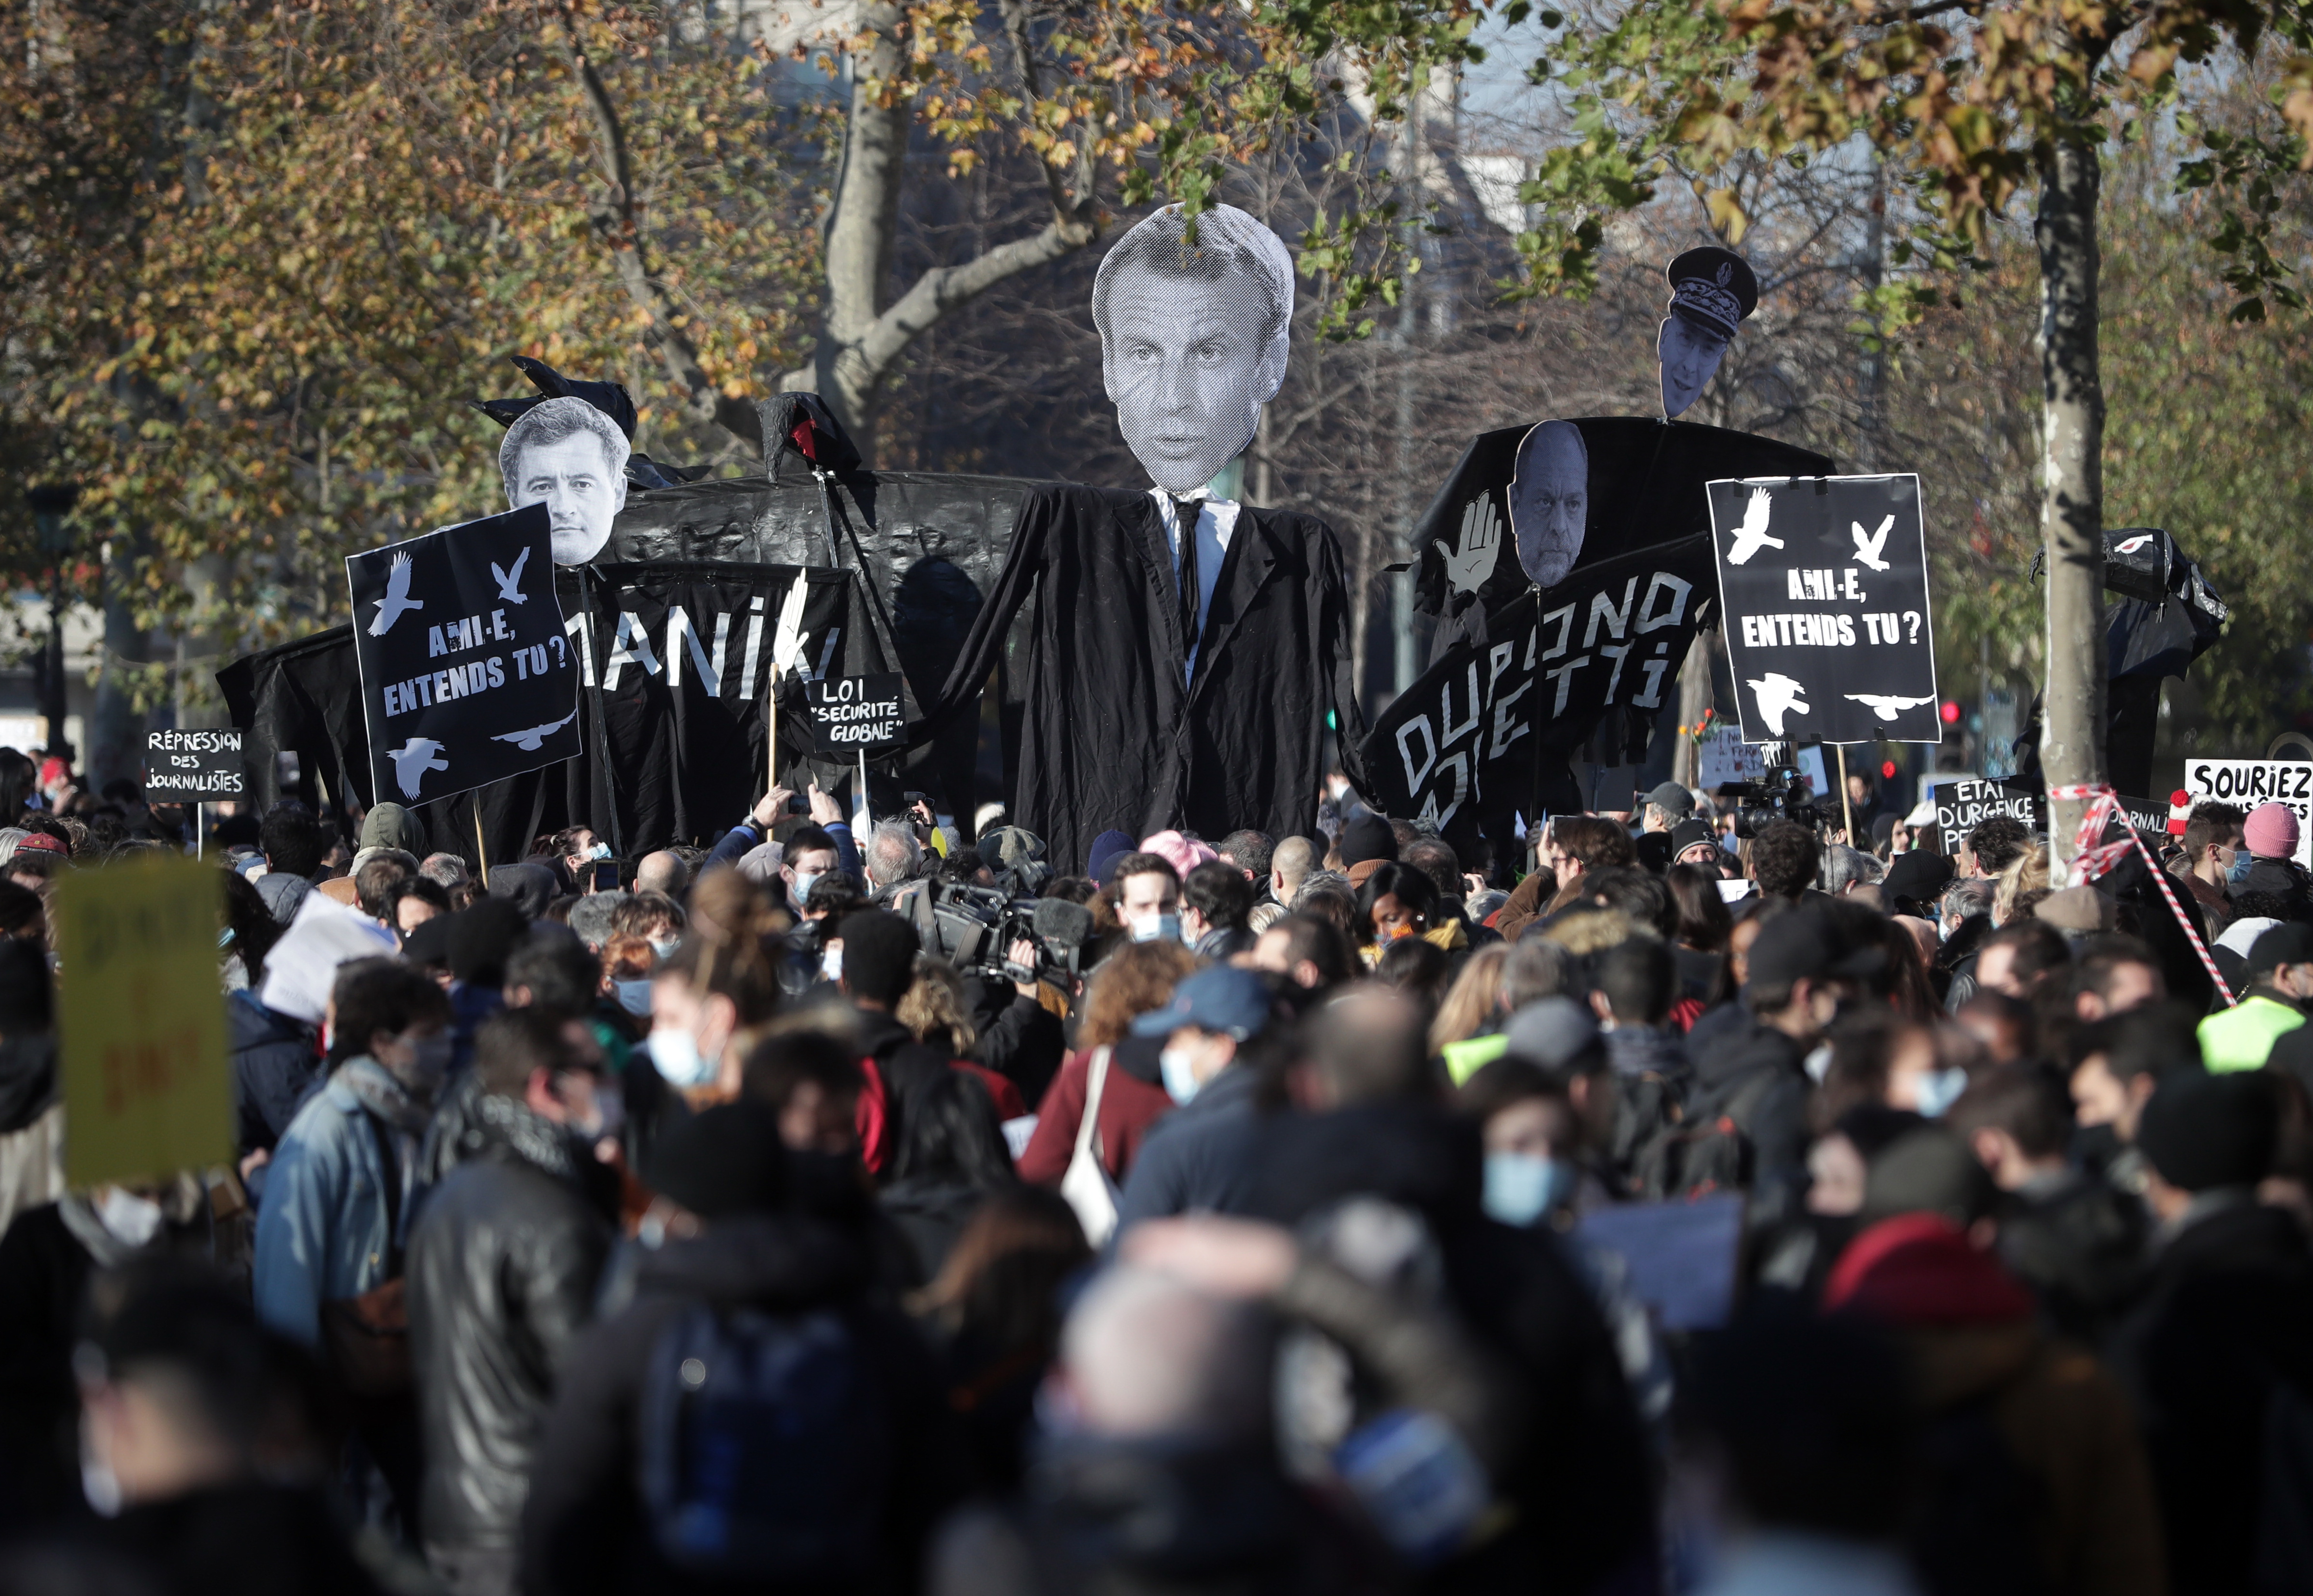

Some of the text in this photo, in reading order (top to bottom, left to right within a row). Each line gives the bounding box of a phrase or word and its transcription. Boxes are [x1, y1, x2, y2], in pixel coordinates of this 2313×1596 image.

[1741, 613, 1856, 647] ENTENDS
[384, 656, 506, 717] ENTENDS
[823, 679, 864, 702] LOI
[1395, 572, 1693, 798] DUPOND
[171, 755, 200, 768] DES
